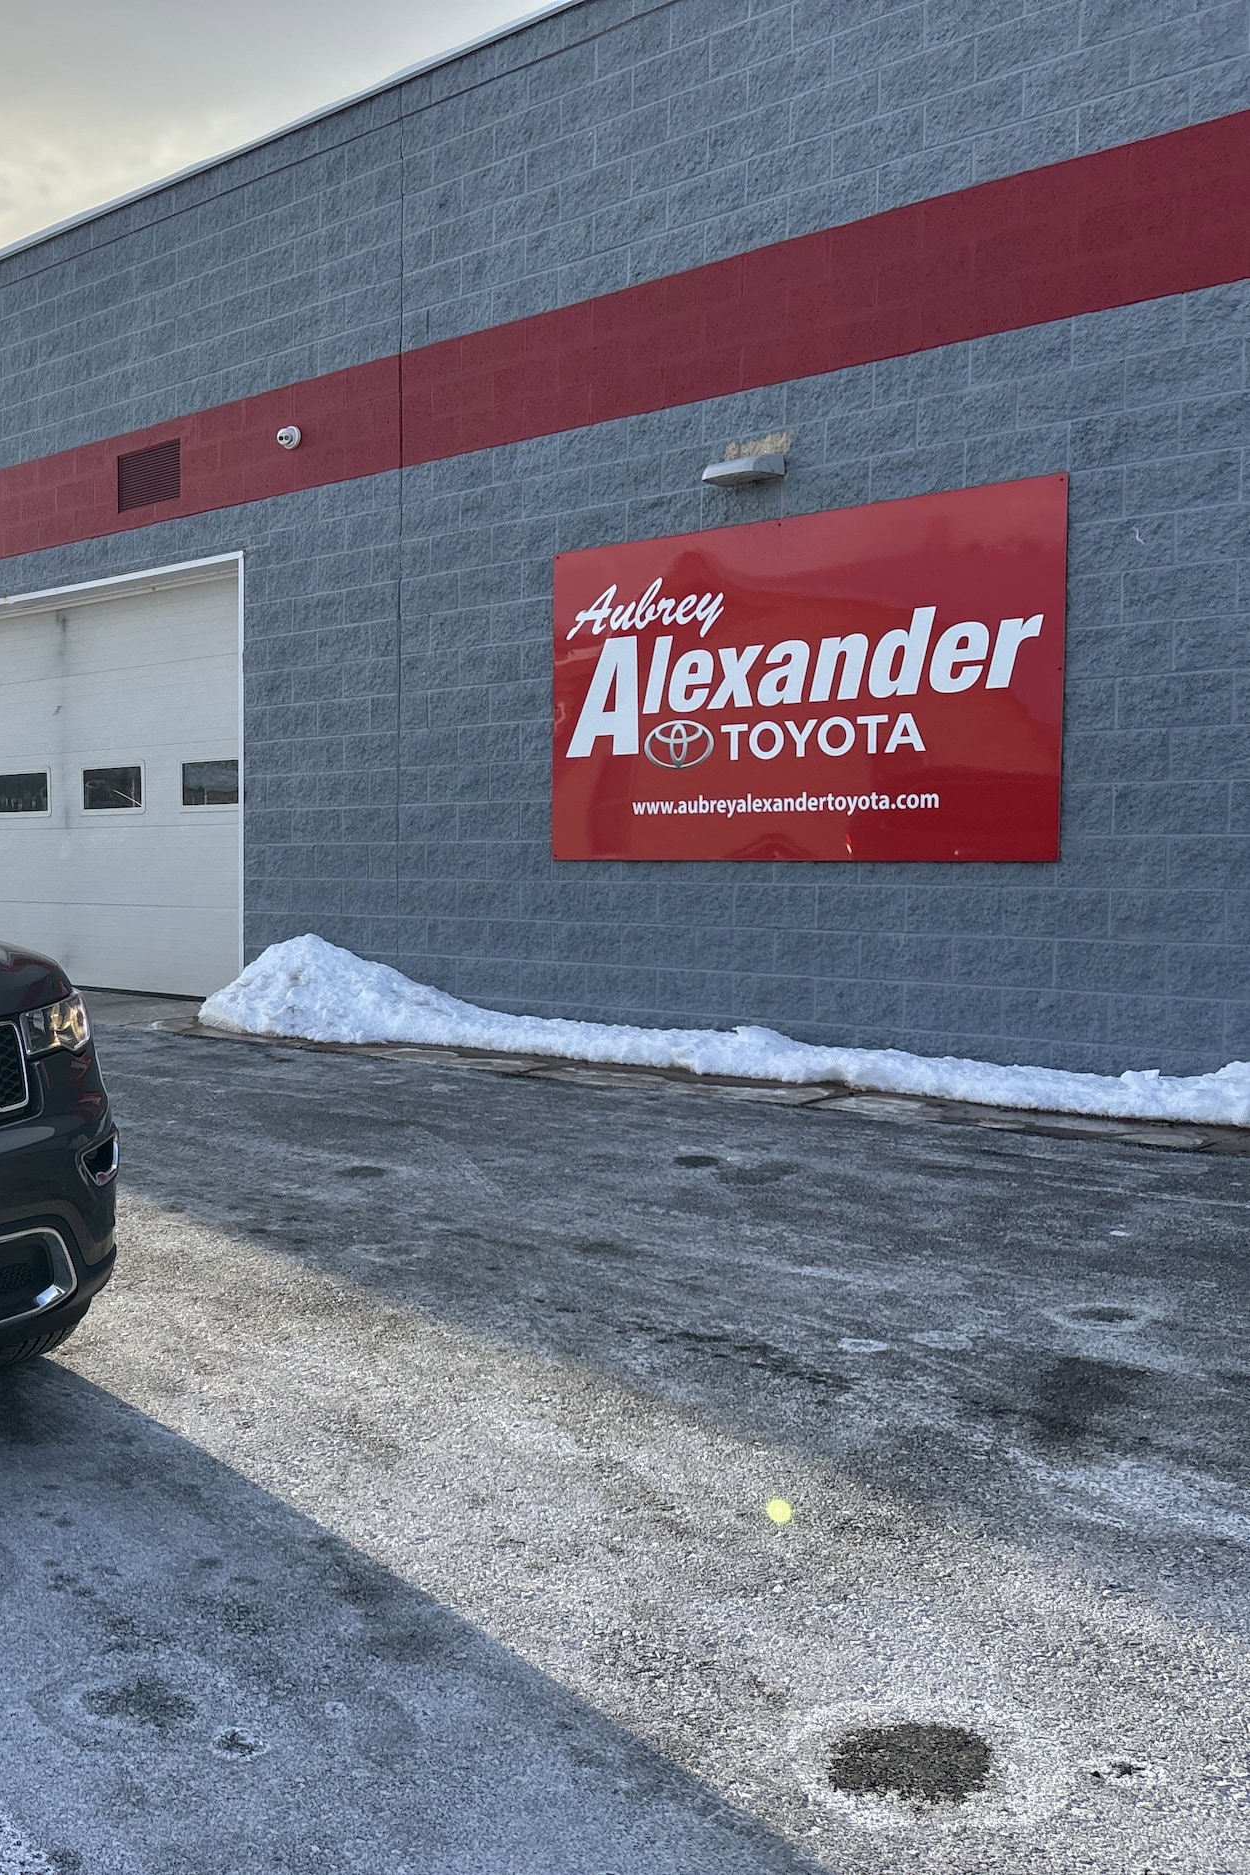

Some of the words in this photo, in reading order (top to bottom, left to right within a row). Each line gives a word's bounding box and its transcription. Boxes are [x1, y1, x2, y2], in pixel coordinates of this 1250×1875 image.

[566, 577, 725, 641] Aubrey
[565, 605, 1045, 759] Alexander
[720, 712, 927, 762] TOYOTA
[631, 790, 940, 819] www.aubreyalexandertoyota.com
